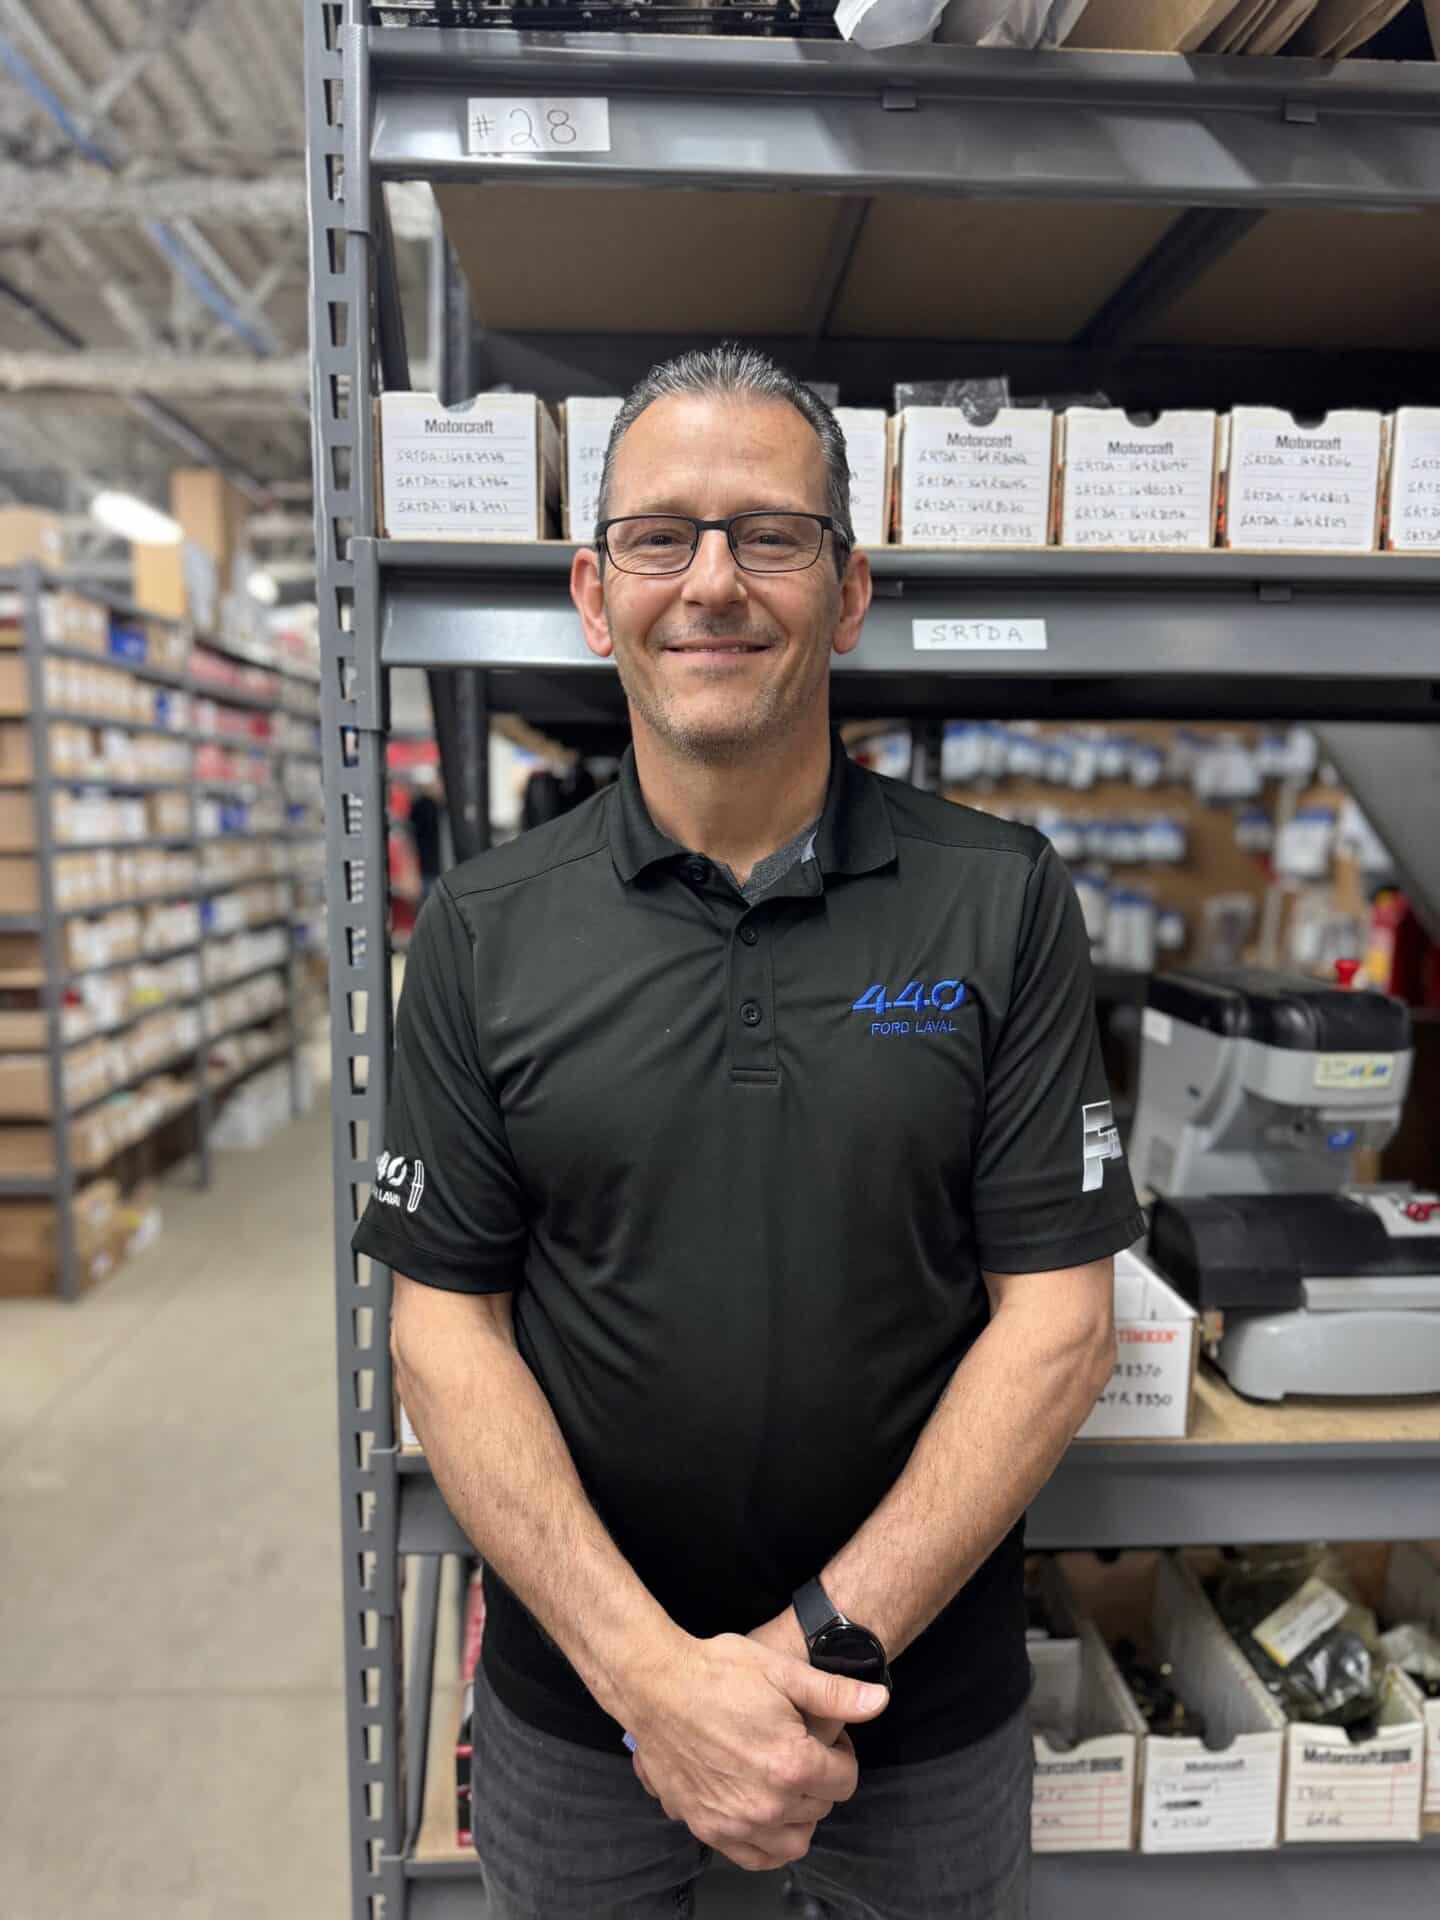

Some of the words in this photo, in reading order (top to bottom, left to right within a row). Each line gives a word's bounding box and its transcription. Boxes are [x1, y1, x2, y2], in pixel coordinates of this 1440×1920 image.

[424, 418, 494, 434] Motorcraft
[946, 432, 1013, 448] Motorcraft
[1107, 441, 1174, 455] Motorcraft
[1275, 435, 1342, 451] Motorcraft
[929, 623, 1025, 643] SRTDA
[871, 1021, 910, 1036] FORD
[915, 1020, 960, 1033] LAVAL
